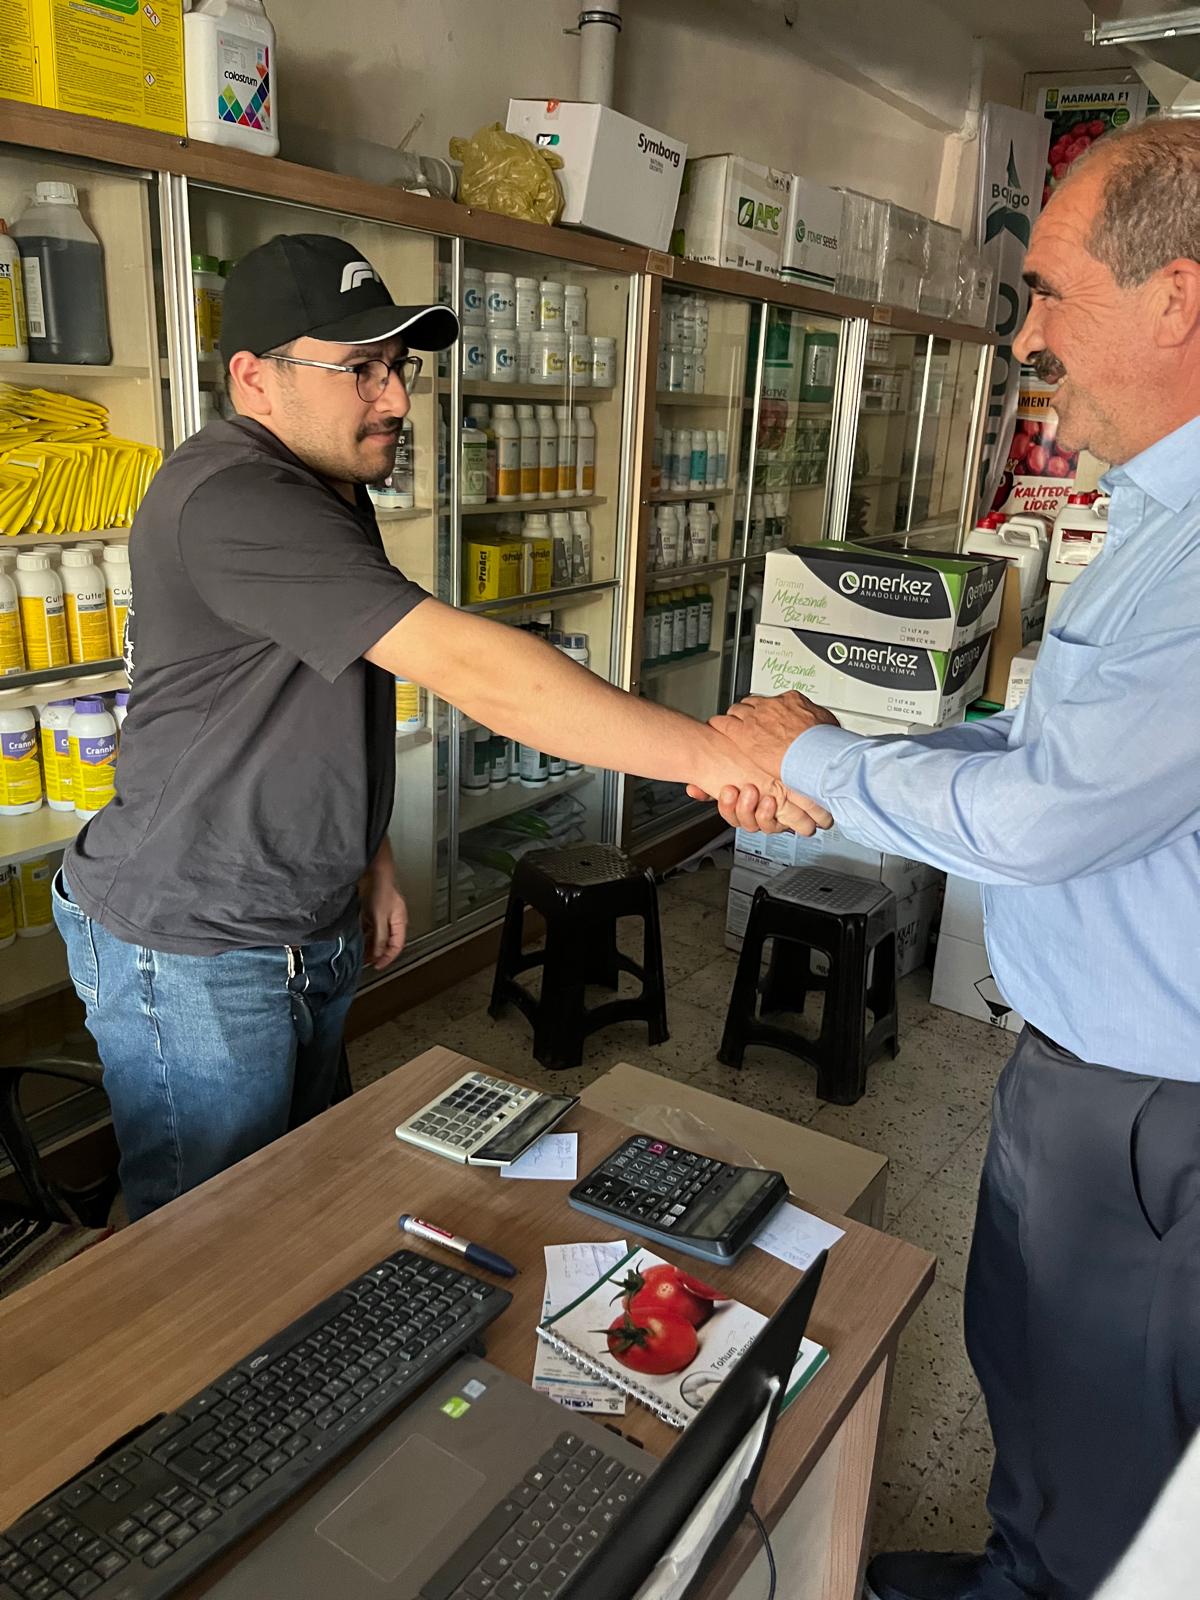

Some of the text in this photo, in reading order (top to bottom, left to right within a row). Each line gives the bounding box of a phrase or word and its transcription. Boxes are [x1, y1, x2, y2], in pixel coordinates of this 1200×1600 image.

[224, 70, 258, 87] colostrum
[1061, 91, 1129, 104] MARMARA F1
[638, 132, 681, 168] Symborg
[1018, 396, 1051, 408] MENT
[1014, 485, 1073, 498] KALİTEDE
[1023, 498, 1059, 511] LİDER
[861, 573, 933, 597] merkez
[860, 590, 930, 604] ANADOLU KİMYA
[849, 646, 919, 669] merkez
[848, 661, 916, 676] ANADOLU KİMYA
[710, 1345, 738, 1370] Tohum
